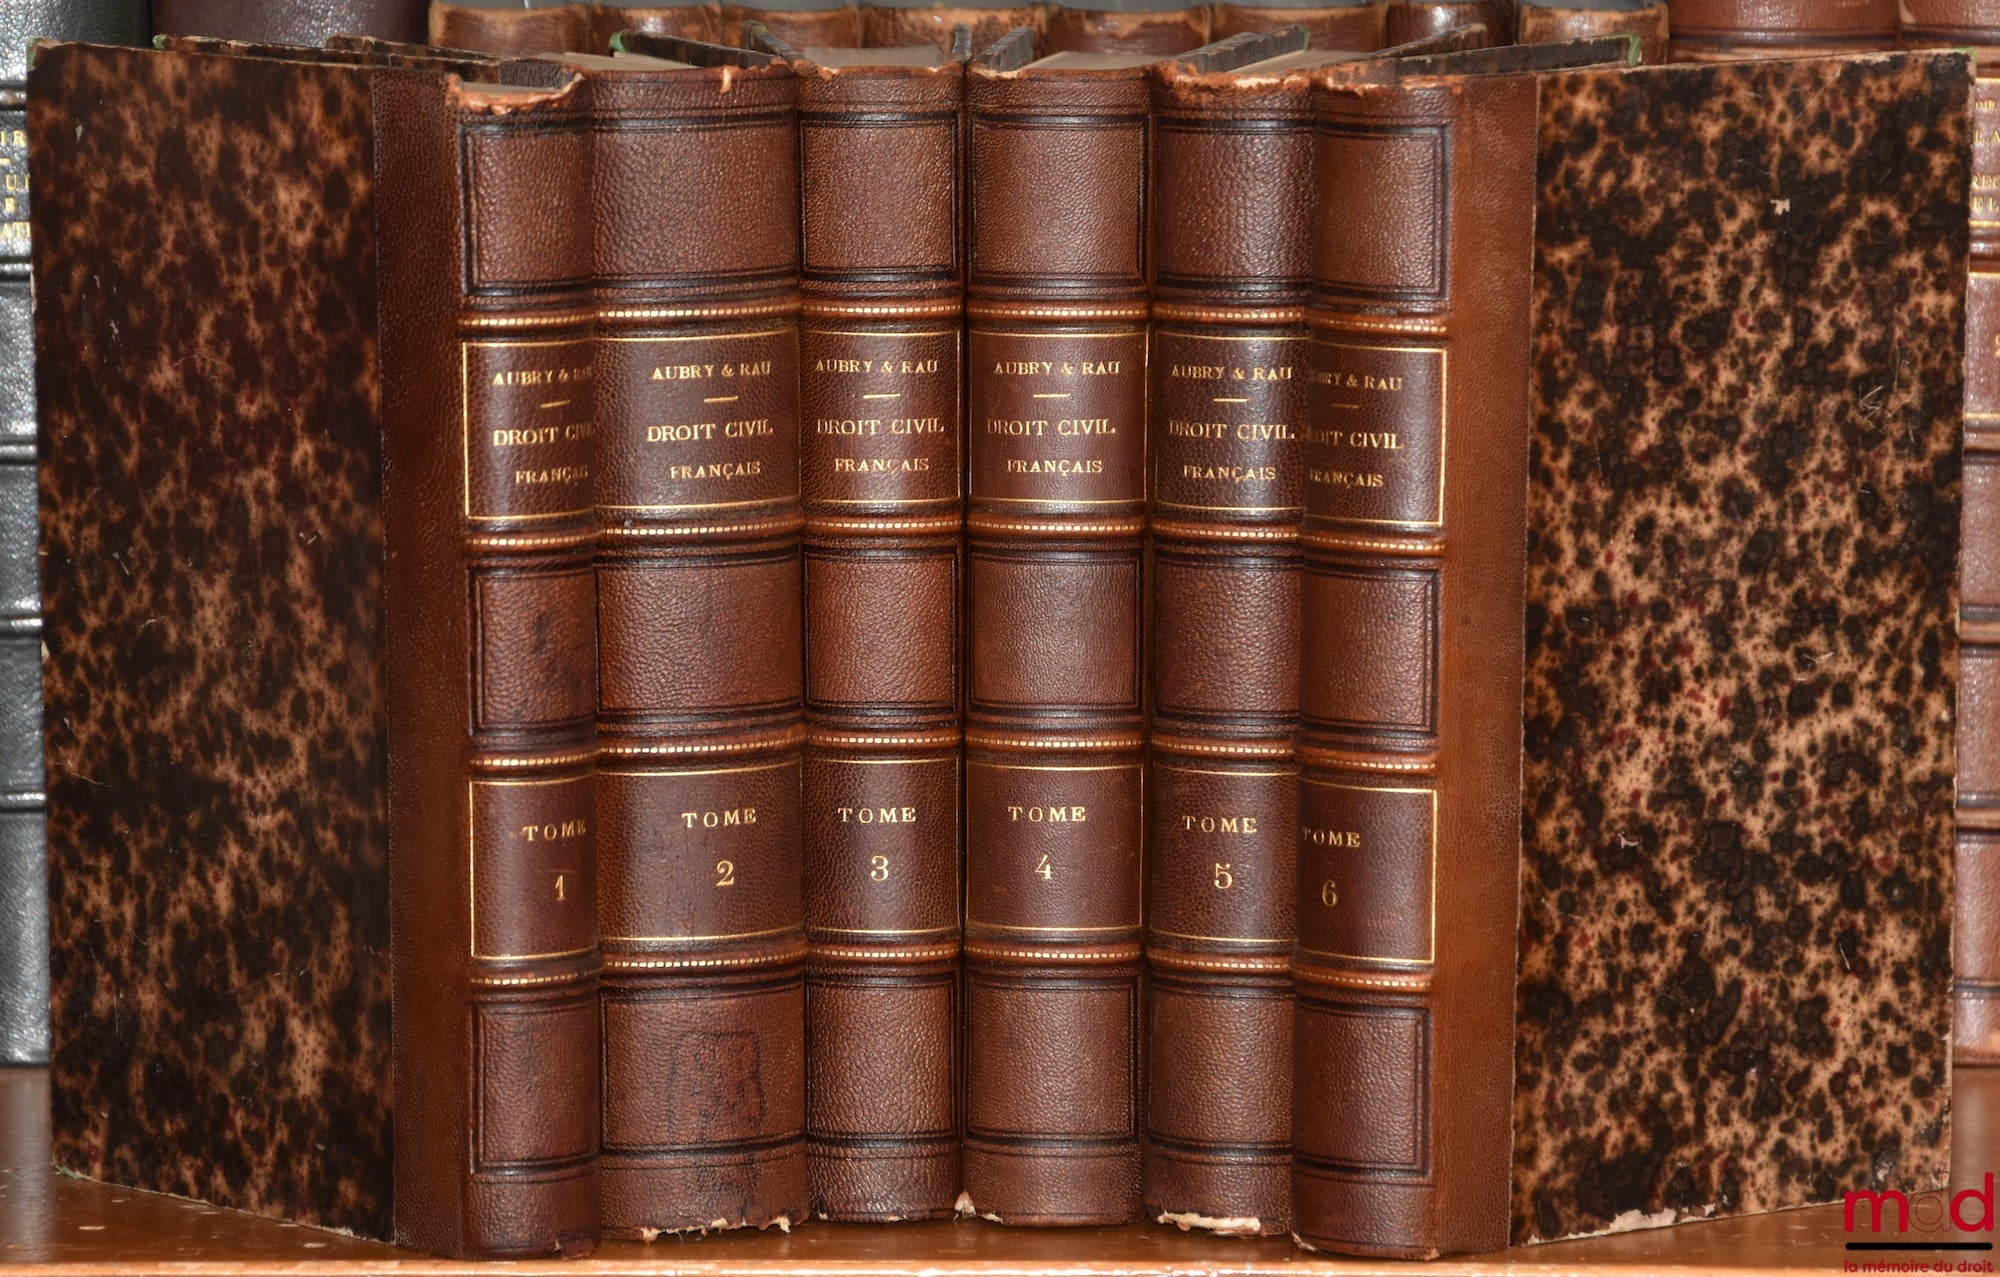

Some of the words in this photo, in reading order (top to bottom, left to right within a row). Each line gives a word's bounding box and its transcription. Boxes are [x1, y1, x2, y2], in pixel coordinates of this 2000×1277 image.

[651, 364, 714, 380] AUBRY
[721, 364, 735, 377] &
[740, 360, 772, 377] RAU
[815, 359, 873, 373] AUBRY
[881, 360, 894, 373] &
[901, 360, 939, 374] RAU
[993, 361, 1053, 376] AUBRY
[1060, 362, 1074, 375] &
[1081, 360, 1121, 375] RAU
[1170, 364, 1226, 380] AUBRY
[1232, 367, 1245, 380] &
[1253, 366, 1293, 381] RAU
[492, 369, 554, 386] AUBRY
[558, 368, 569, 383] &
[1346, 374, 1360, 388] &
[1363, 375, 1404, 391] RAU
[646, 423, 716, 442] DROIT
[725, 418, 774, 438] CIVIL
[816, 419, 881, 435] DROIT
[891, 417, 945, 435] CIVIL
[987, 419, 1048, 436] DROIT
[1057, 418, 1116, 436] CIVIL
[1168, 420, 1228, 440] DROIT
[1236, 423, 1296, 441] CIVIL
[493, 426, 559, 447] DROIT
[1349, 431, 1405, 450] CIVIL
[670, 460, 762, 481] FRANÇAIS
[834, 457, 930, 475] FRANÇAIS
[1006, 459, 1103, 477] FRANÇAIS
[1183, 464, 1277, 484] FRANÇAIS
[682, 807, 757, 829] TOME
[837, 807, 917, 824] TOME
[1008, 806, 1086, 822] TOME
[521, 819, 586, 842] TOME
[1182, 815, 1258, 834] TOME
[1302, 825, 1361, 848] TOME
[715, 860, 735, 887] 2
[870, 855, 890, 881] 3
[1034, 854, 1053, 880] 4
[1214, 863, 1234, 890] 5
[554, 874, 567, 902] 1
[1321, 879, 1339, 907] 6
